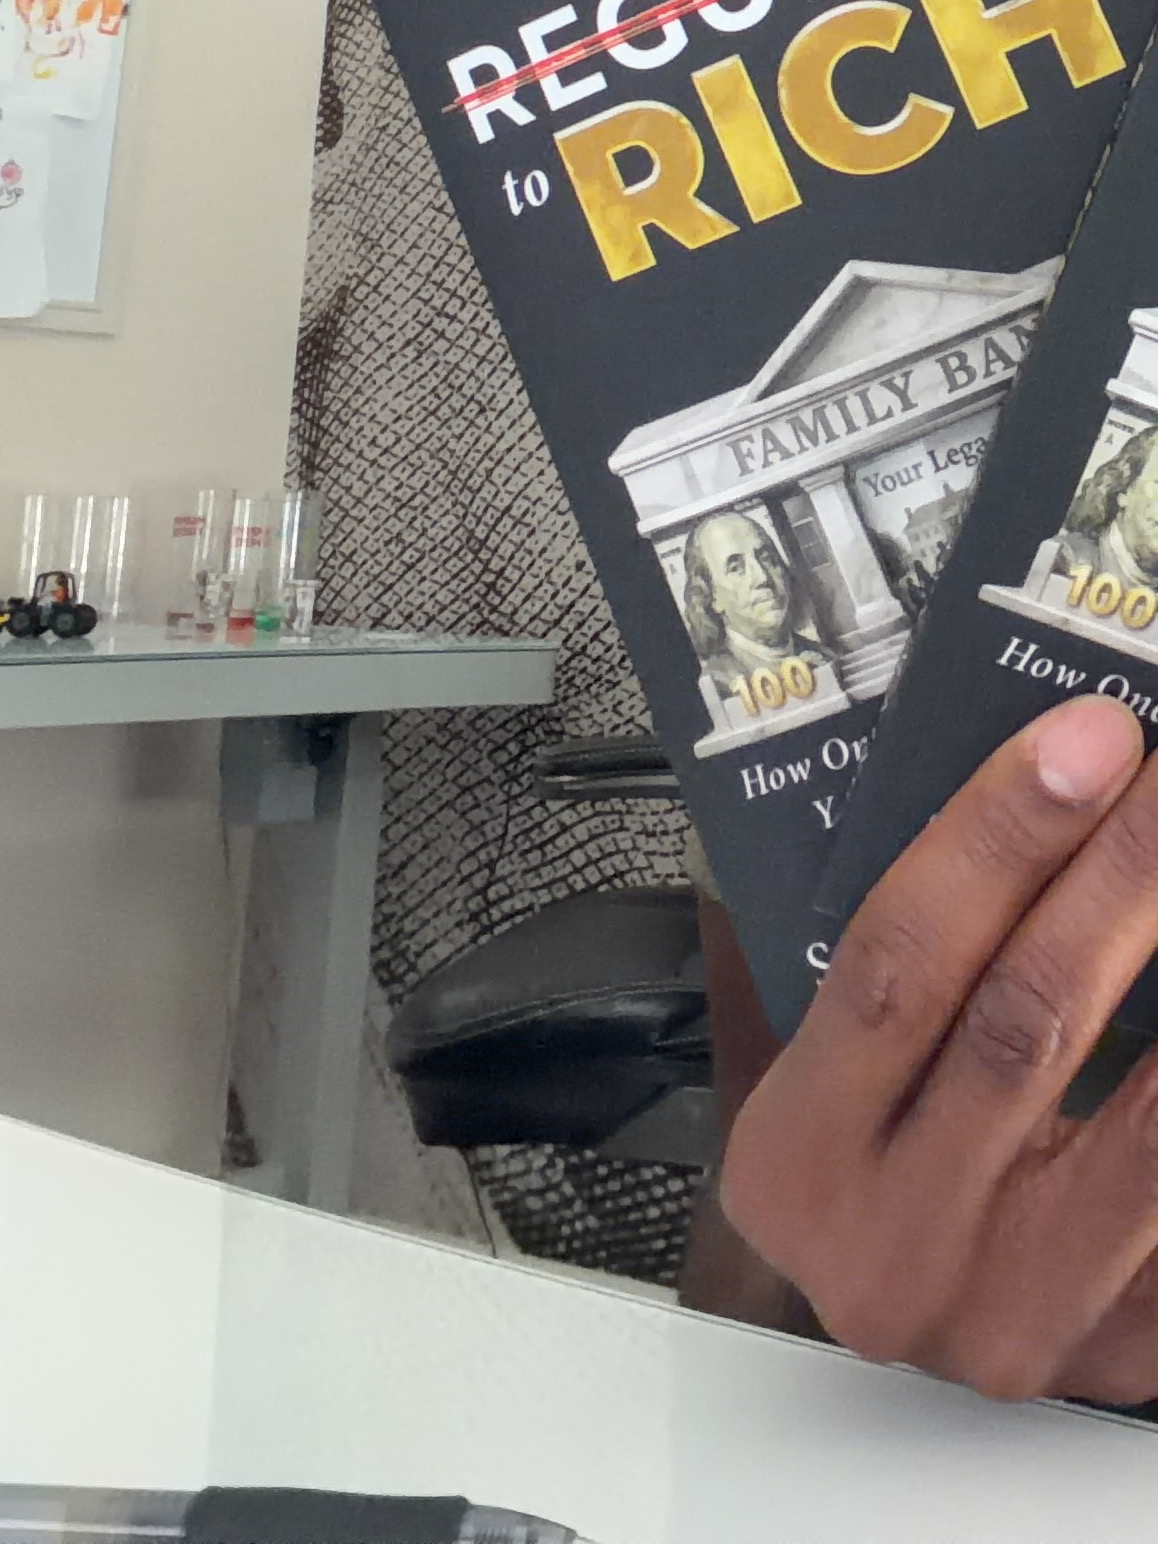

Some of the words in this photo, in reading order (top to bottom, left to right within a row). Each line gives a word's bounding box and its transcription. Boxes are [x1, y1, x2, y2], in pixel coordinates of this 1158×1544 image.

[502, 166, 550, 218] to
[725, 369, 918, 478] FAMILY
[934, 313, 1040, 394] BAN
[862, 462, 924, 498] Your
[926, 436, 987, 473] Lega
[1064, 563, 1158, 631] 100
[730, 656, 817, 718] 100
[995, 636, 1087, 690] How
[740, 758, 811, 801] How
